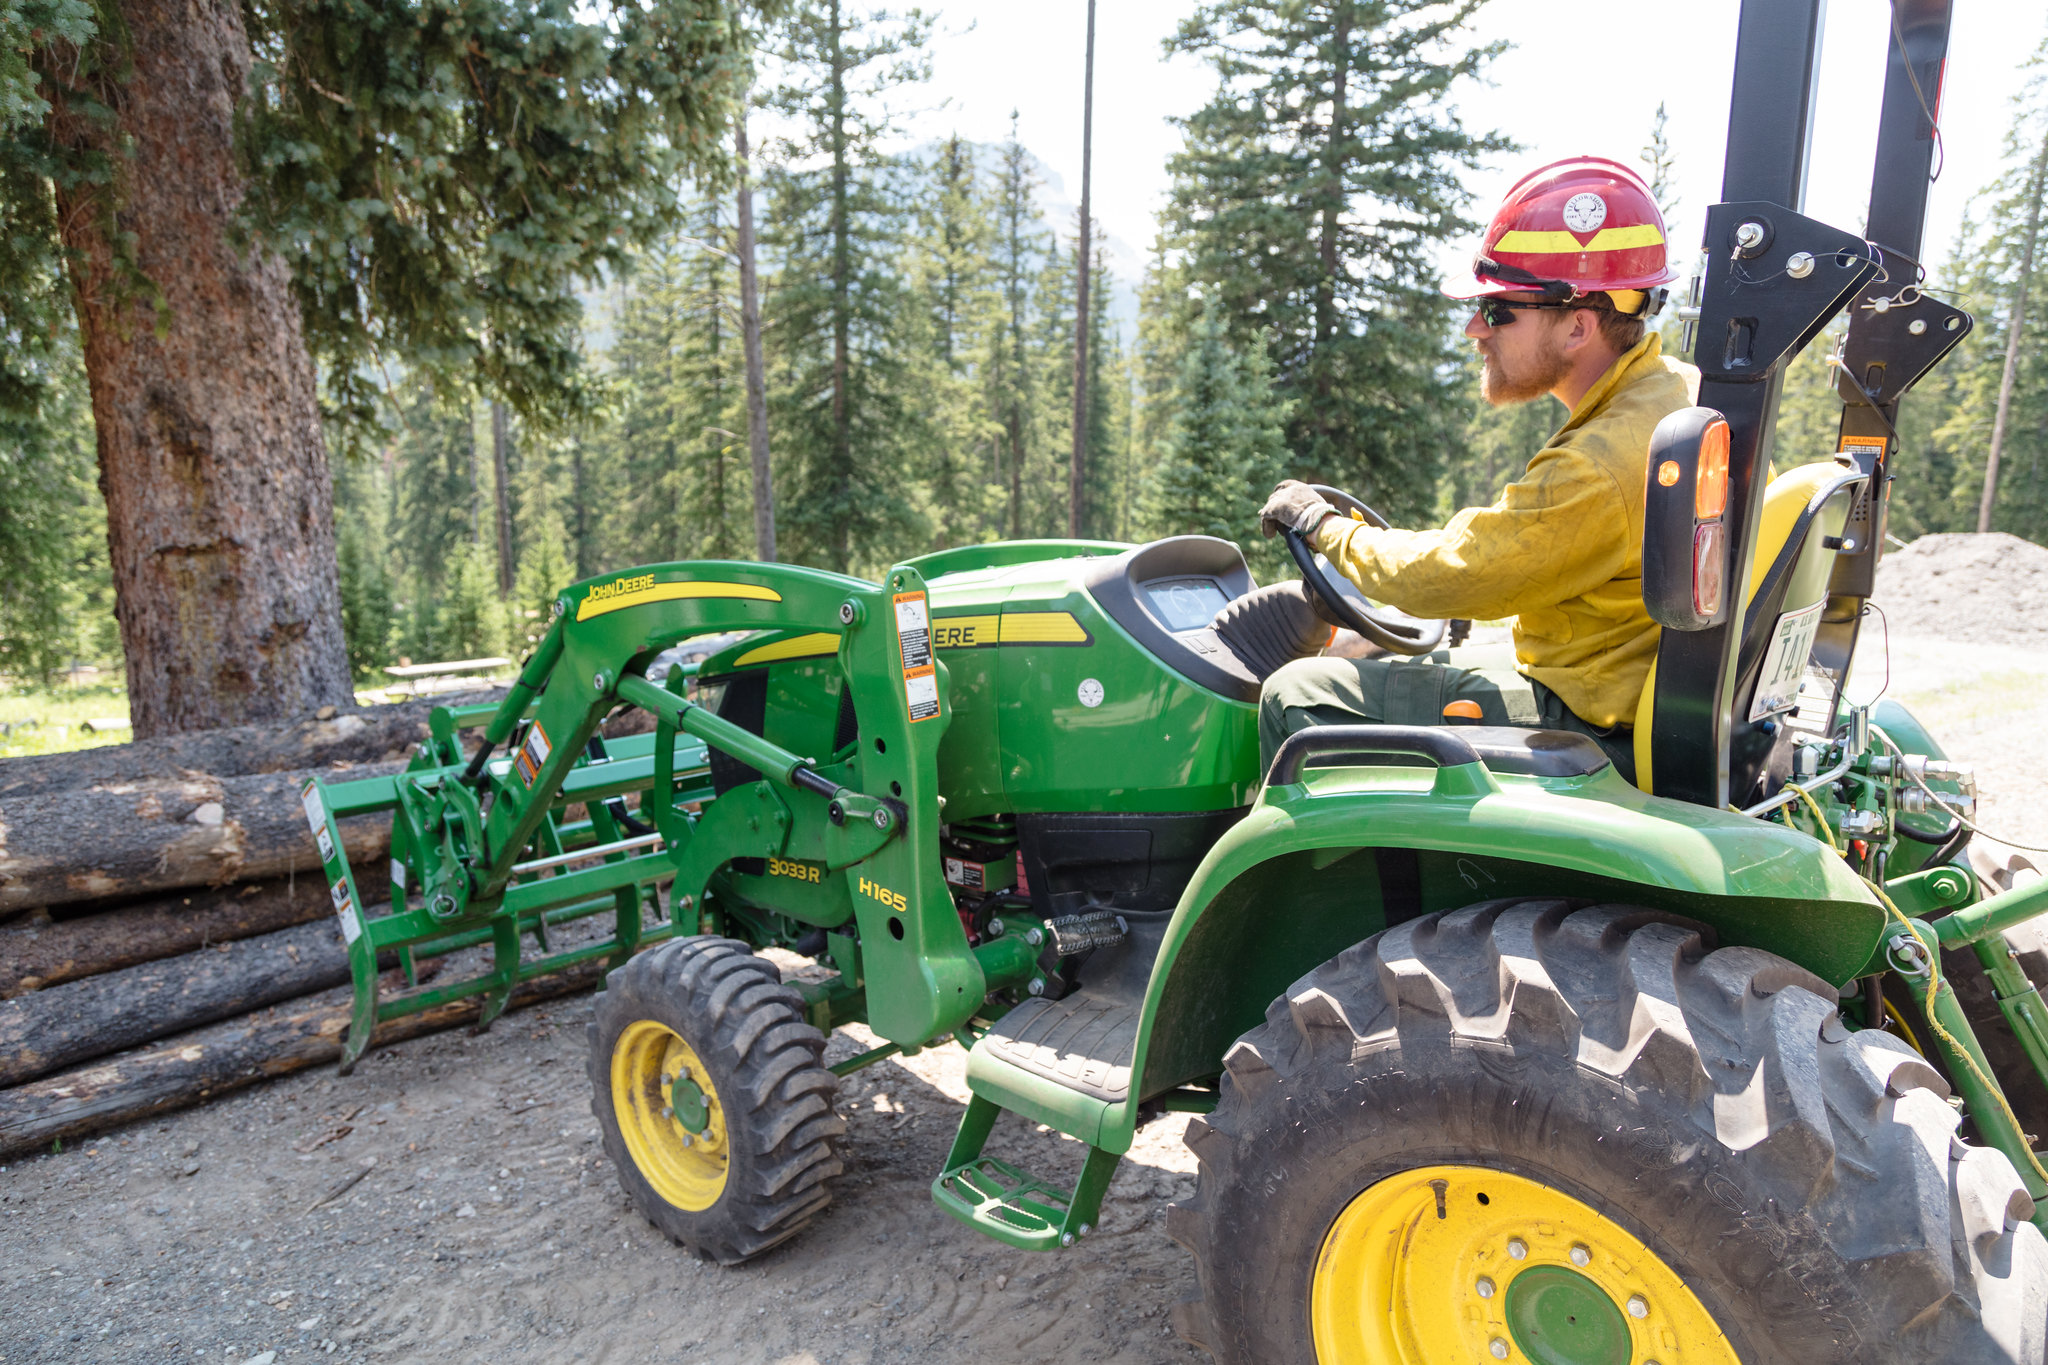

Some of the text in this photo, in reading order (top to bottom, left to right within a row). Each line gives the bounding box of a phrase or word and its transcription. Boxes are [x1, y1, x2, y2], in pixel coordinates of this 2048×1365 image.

[586, 573, 655, 602] JOHN DEERE
[859, 877, 907, 912] H165
